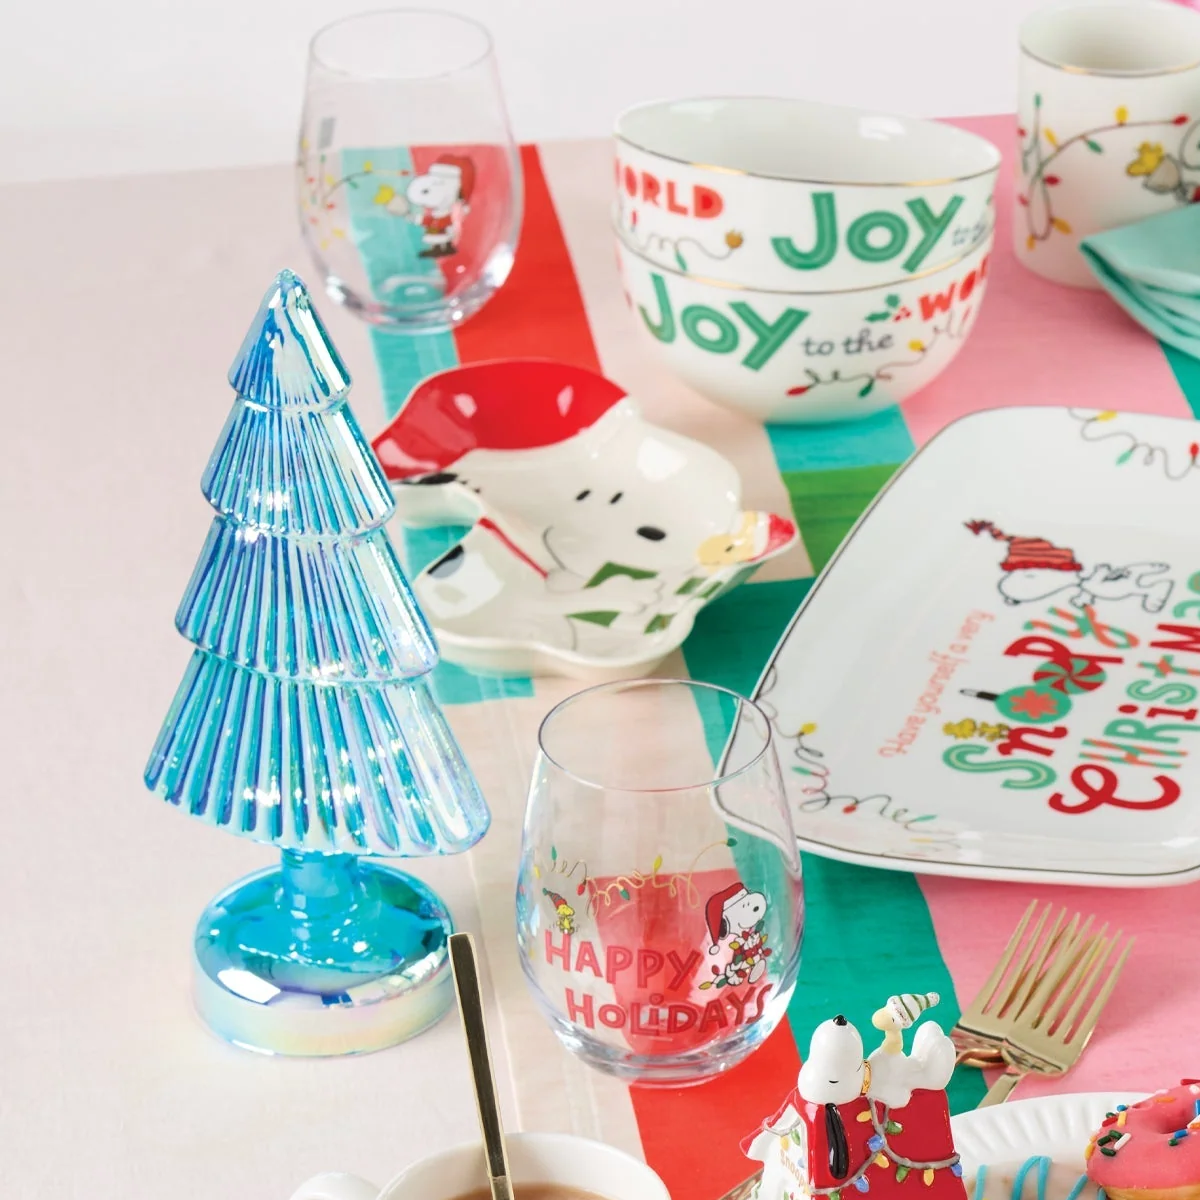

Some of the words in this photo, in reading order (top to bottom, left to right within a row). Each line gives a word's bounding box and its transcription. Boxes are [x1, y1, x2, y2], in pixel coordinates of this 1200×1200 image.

[615, 157, 724, 220] ORLD
[802, 336, 835, 357] to
[841, 326, 895, 357] the
[544, 930, 703, 990] HAPPY
